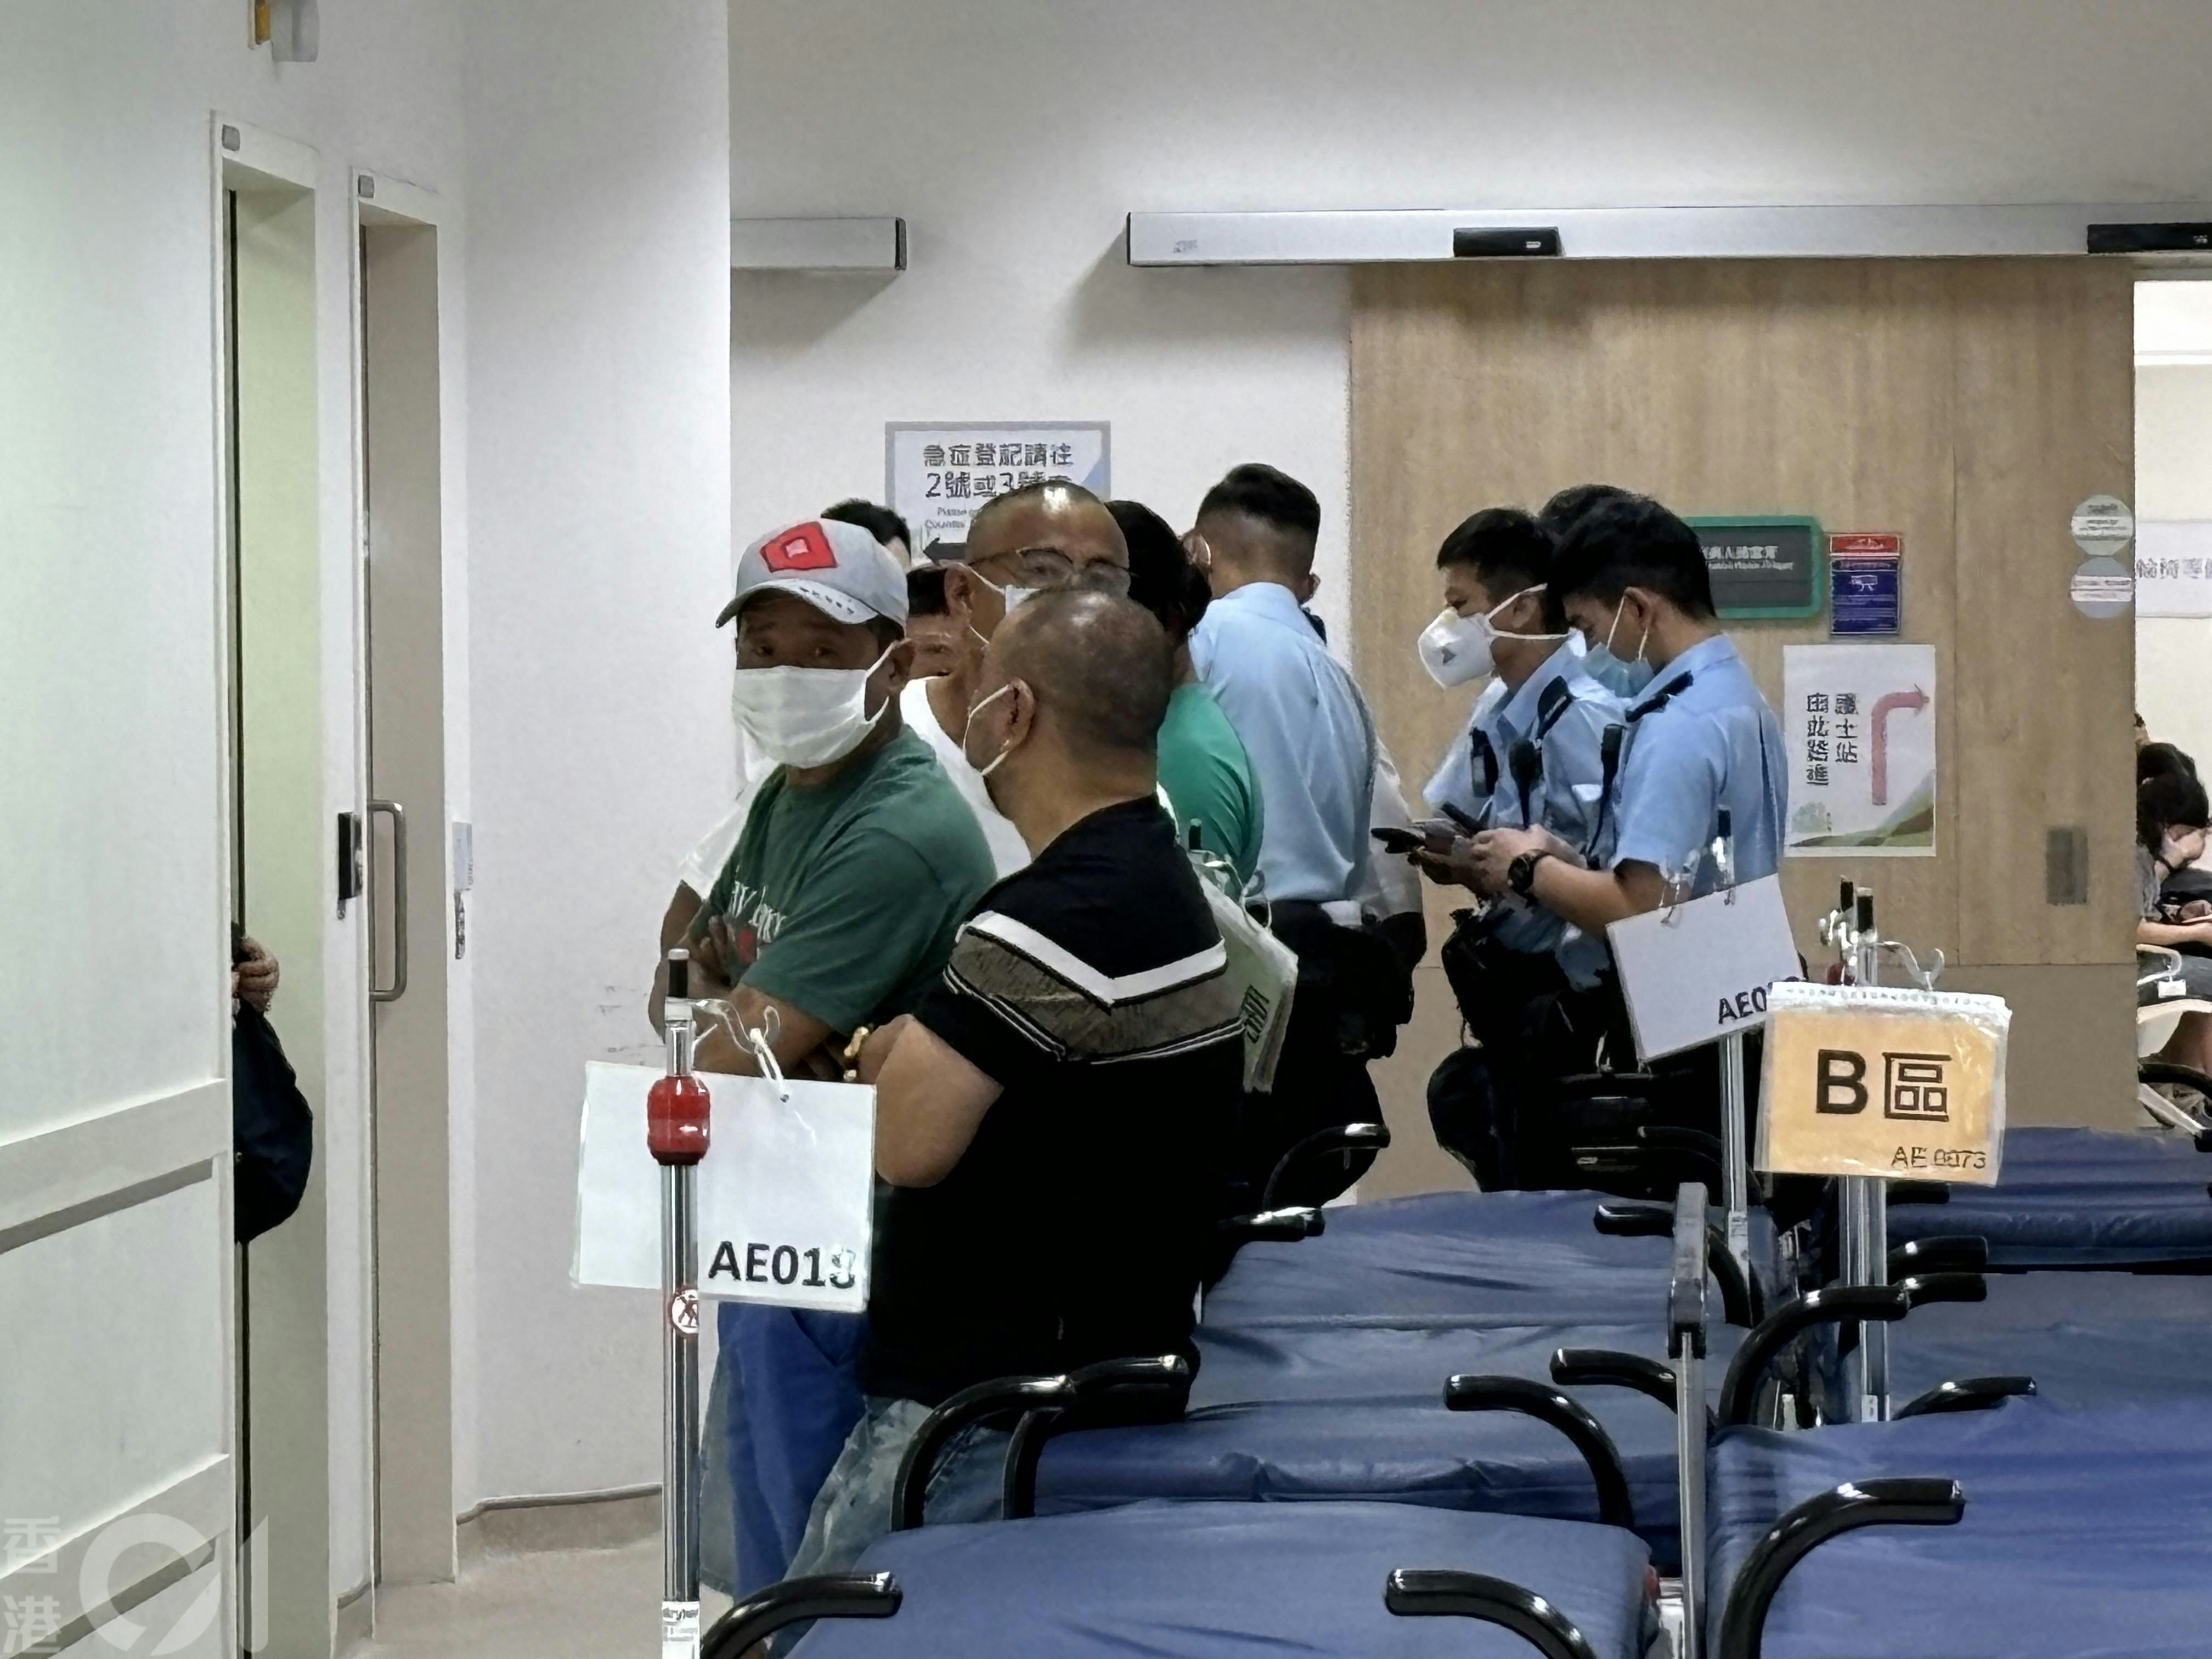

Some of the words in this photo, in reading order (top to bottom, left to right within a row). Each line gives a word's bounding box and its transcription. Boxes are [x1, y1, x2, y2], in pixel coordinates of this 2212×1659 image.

[923, 442, 1074, 467] 急症登記請往
[1816, 1048, 1952, 1122] B區
[1891, 1146, 1928, 1169] AE
